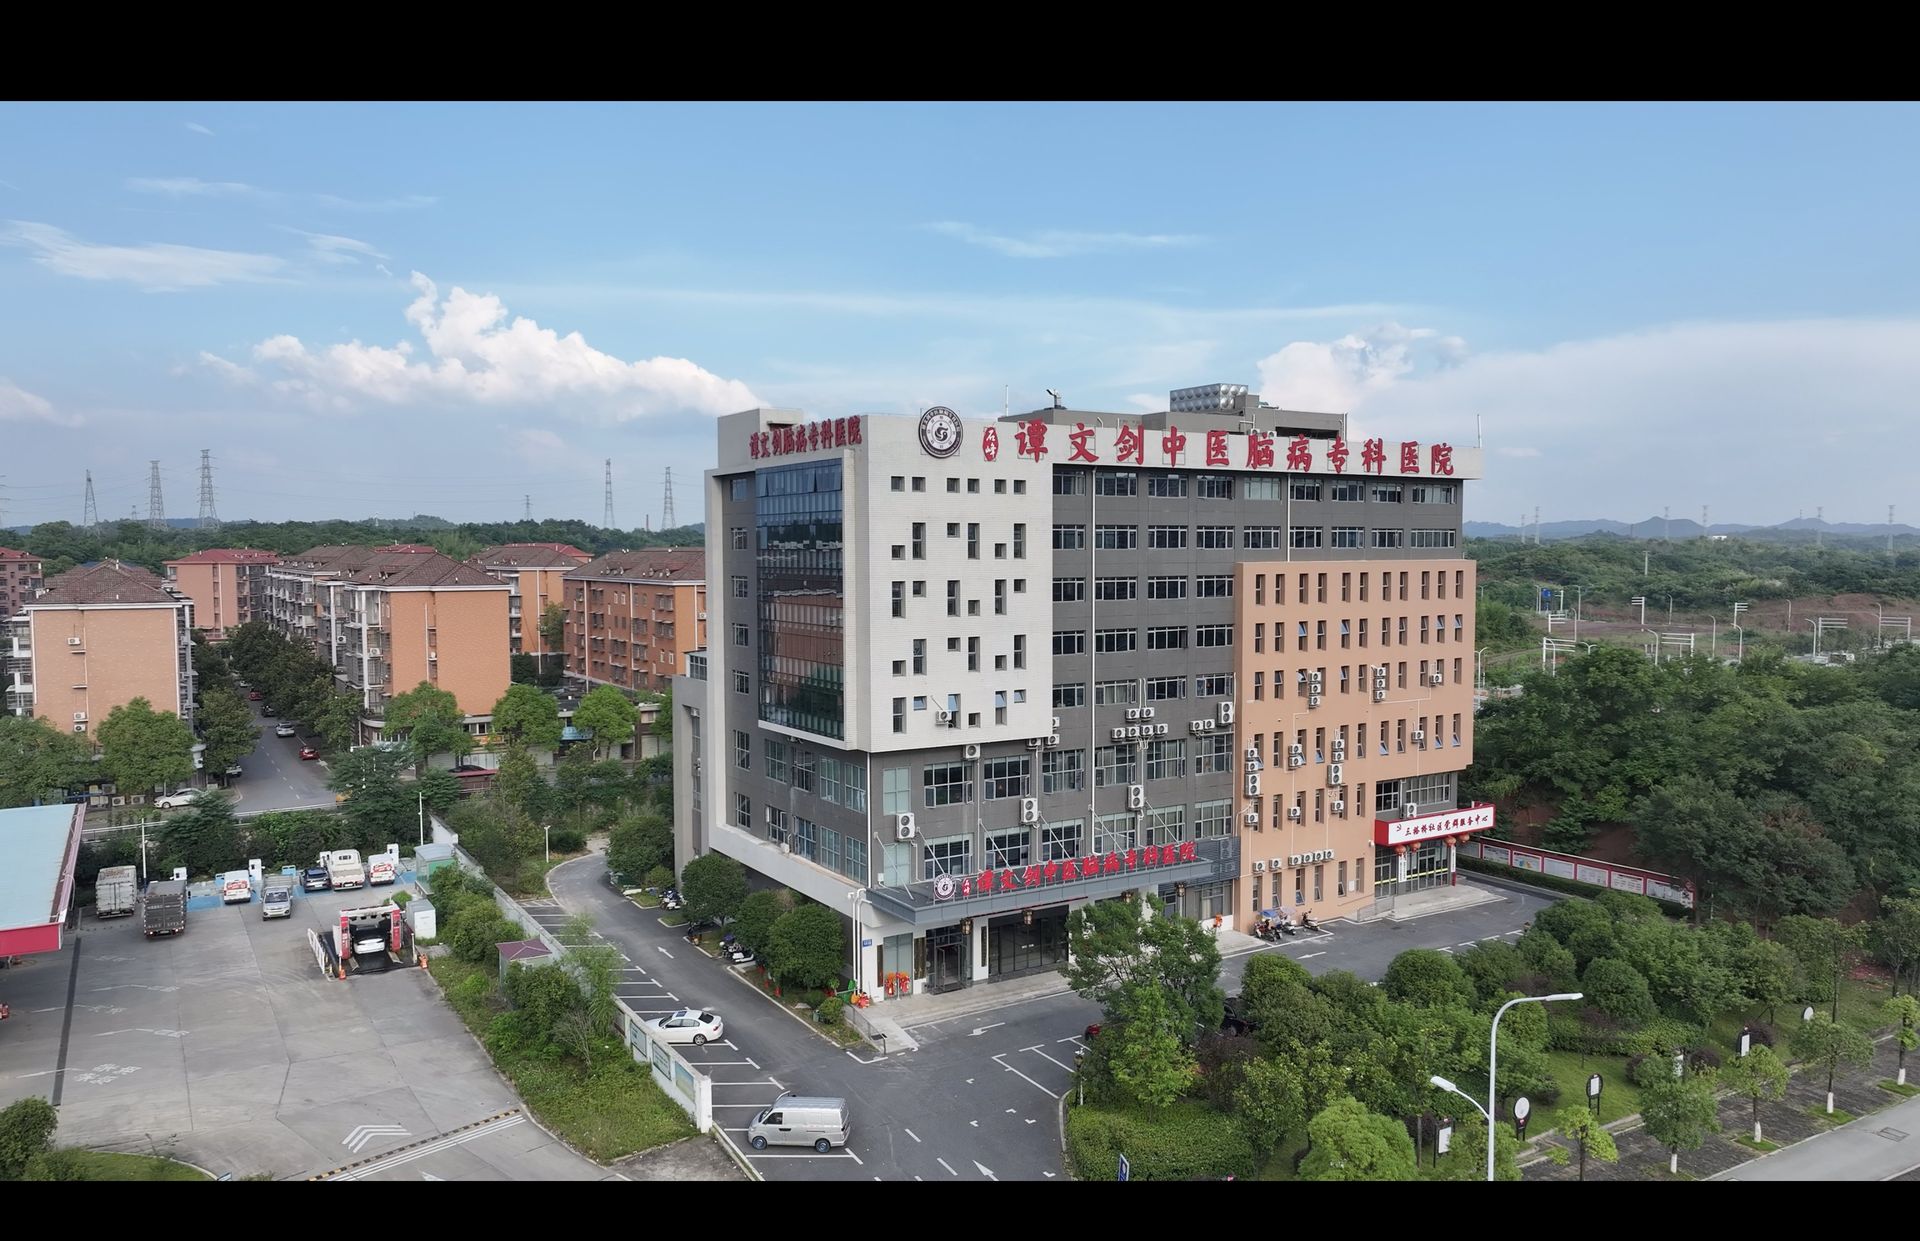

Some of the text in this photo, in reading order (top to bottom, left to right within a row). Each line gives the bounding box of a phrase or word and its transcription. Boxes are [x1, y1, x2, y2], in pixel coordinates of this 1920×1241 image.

[984, 428, 998, 459] 石峰
[1014, 418, 1455, 477] 谭文剑中医脑病专科医院
